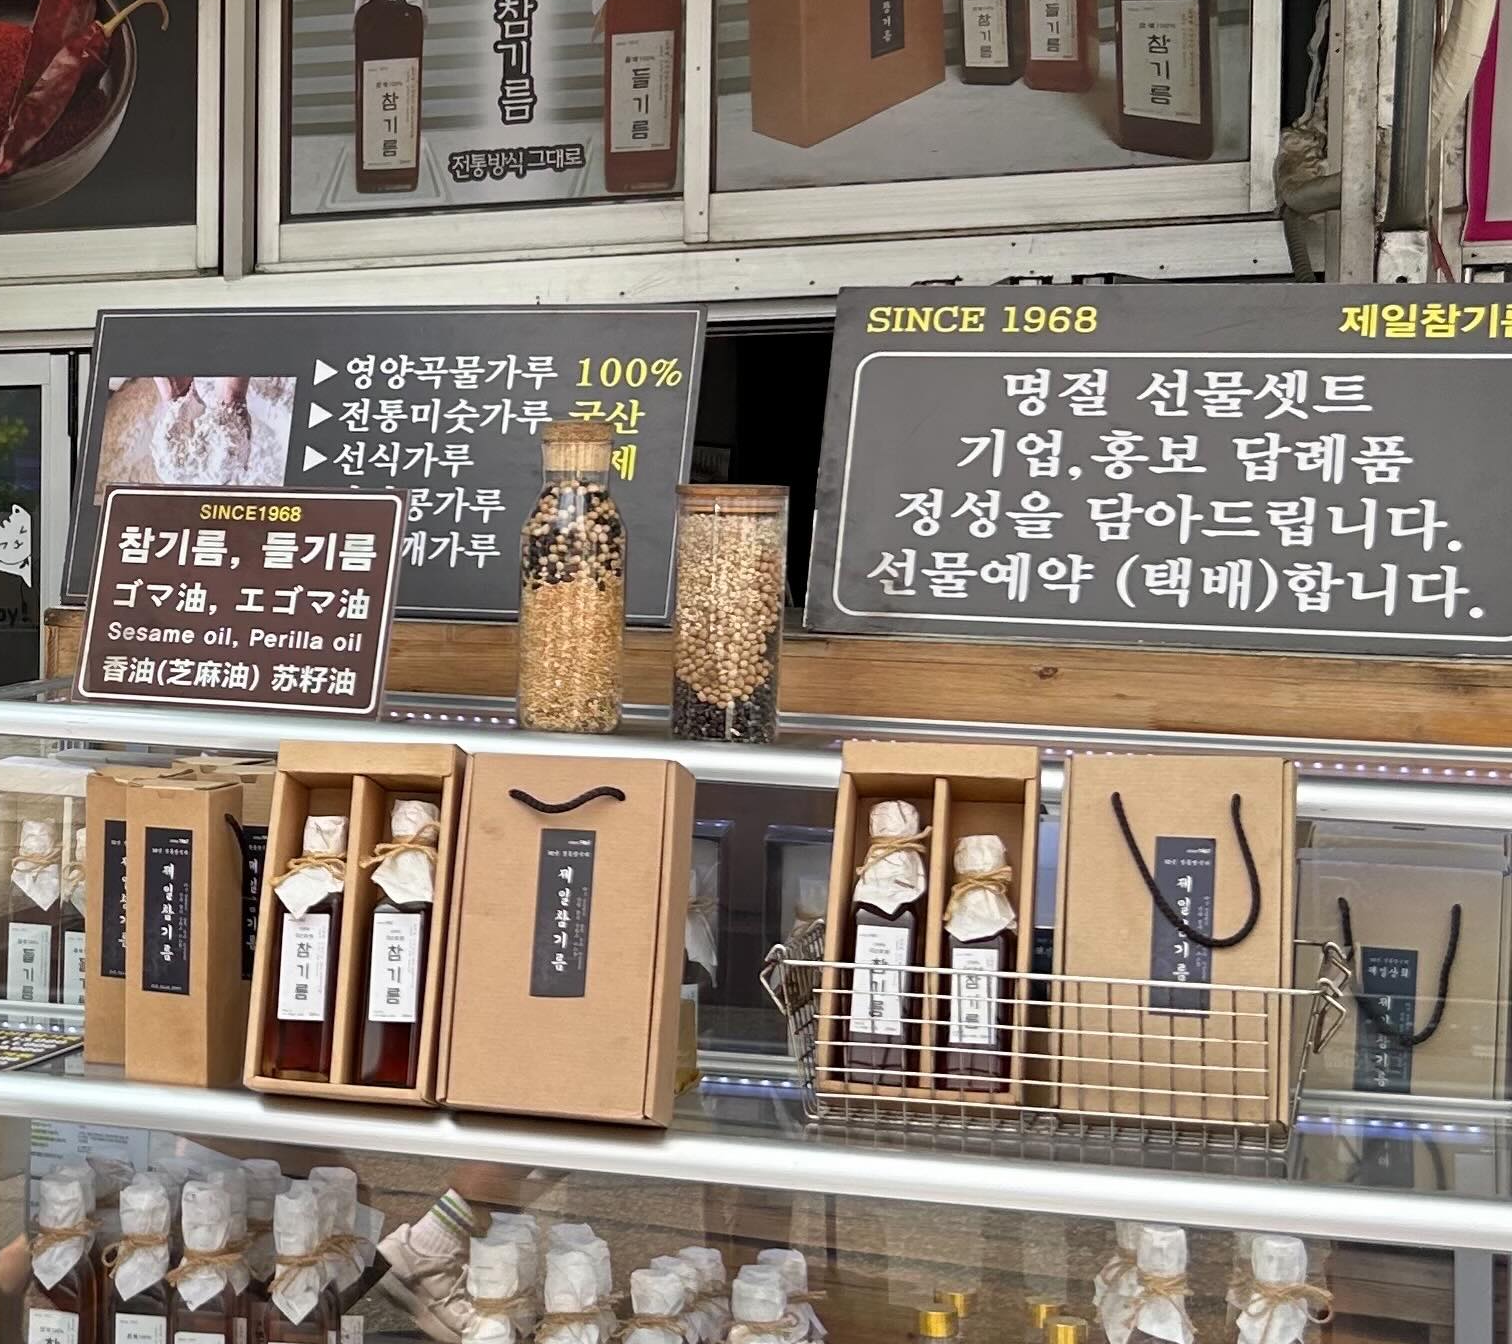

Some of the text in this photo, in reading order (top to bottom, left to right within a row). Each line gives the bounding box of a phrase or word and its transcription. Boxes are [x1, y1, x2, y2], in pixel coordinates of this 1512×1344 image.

[1147, 33, 1172, 105] 참기름
[382, 92, 399, 157] 참기름
[451, 147, 583, 179] 전통방식 그대로
[866, 306, 1099, 334] SINCE 1968
[346, 354, 683, 391] 영양곡물가루 100%
[1002, 368, 1373, 420] 명절 선물셋트
[338, 398, 553, 436] 전통미숫가루
[332, 442, 476, 479] 선식가루
[1234, 433, 1414, 486] 답례품
[894, 487, 1463, 553] 정성을 담아드립니다.
[118, 525, 378, 574] 참기름, 들기름
[234, 585, 371, 621] エゴマ油
[866, 549, 1485, 621] 선물예약 (택배)합니다.
[107, 622, 363, 654] Sesame oil, Perilla oil
[101, 656, 357, 697] 香油(芝麻油) 苏籽油
[295, 942, 312, 1001] 참기름
[386, 944, 403, 1005] 참기름
